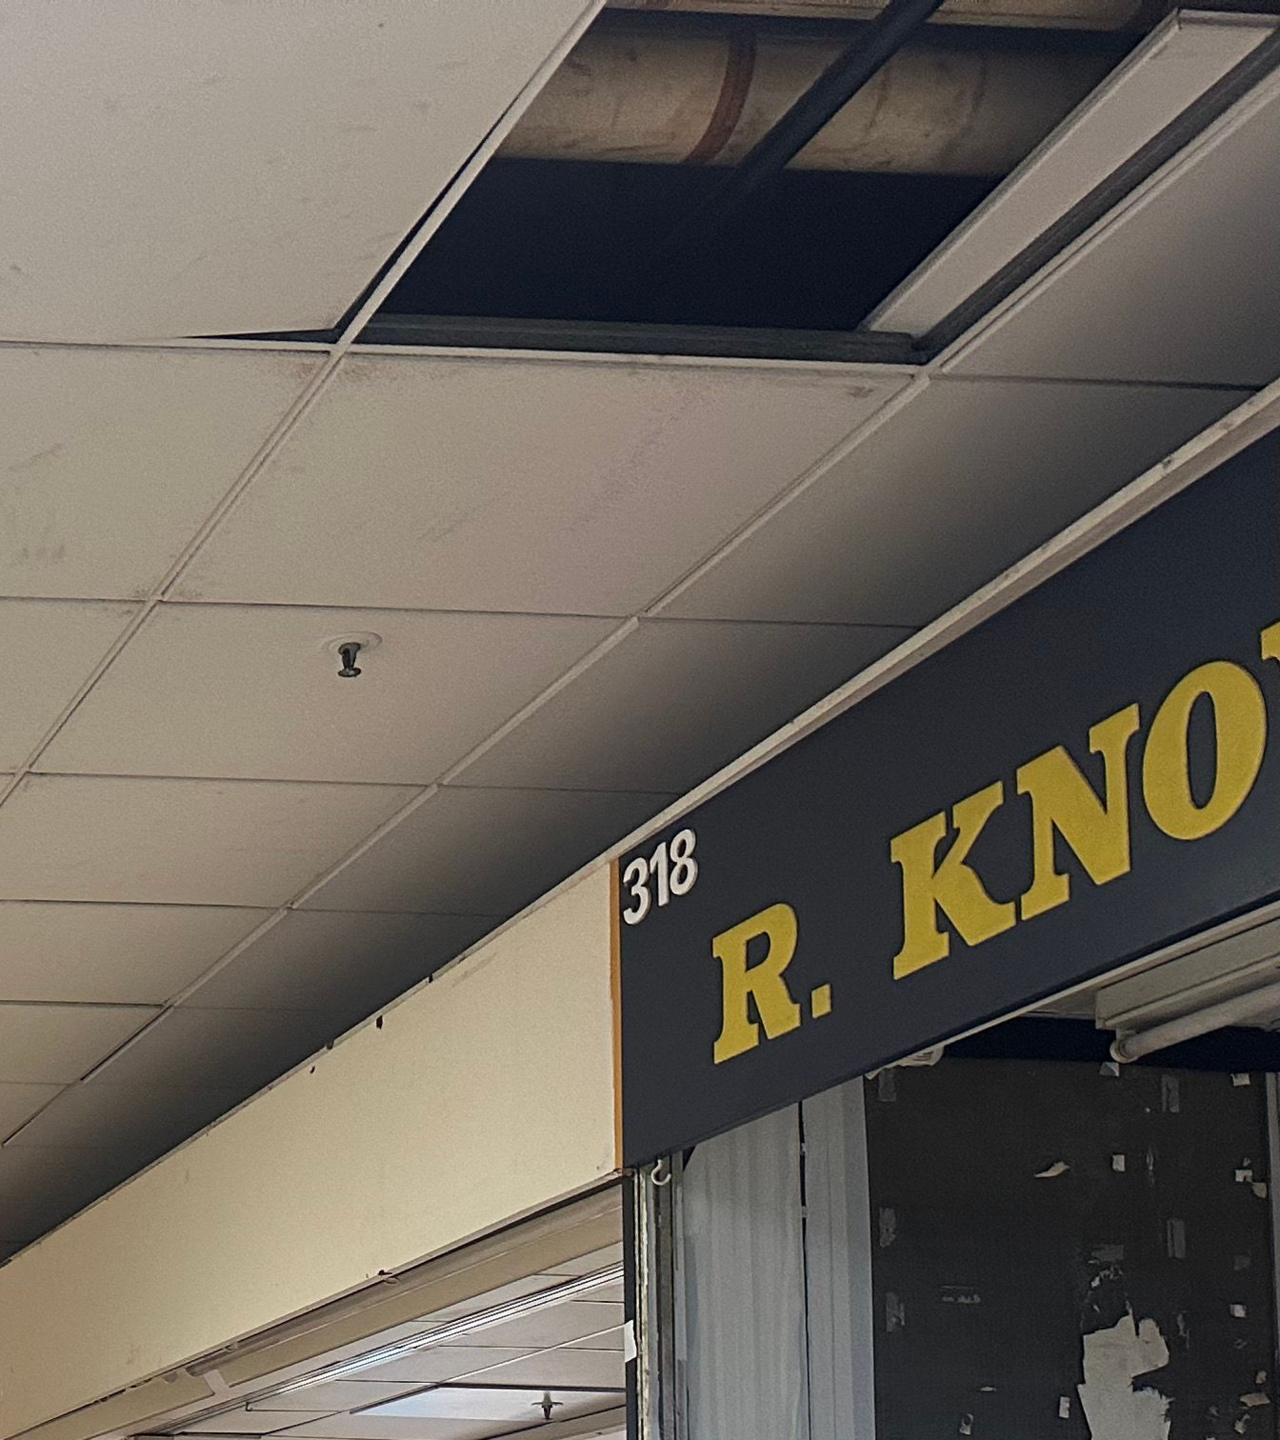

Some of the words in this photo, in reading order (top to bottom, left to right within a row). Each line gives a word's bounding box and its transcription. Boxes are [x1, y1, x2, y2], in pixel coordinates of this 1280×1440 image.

[622, 827, 698, 926] 318
[712, 903, 831, 1065] R.
[889, 620, 1280, 981] KNO
